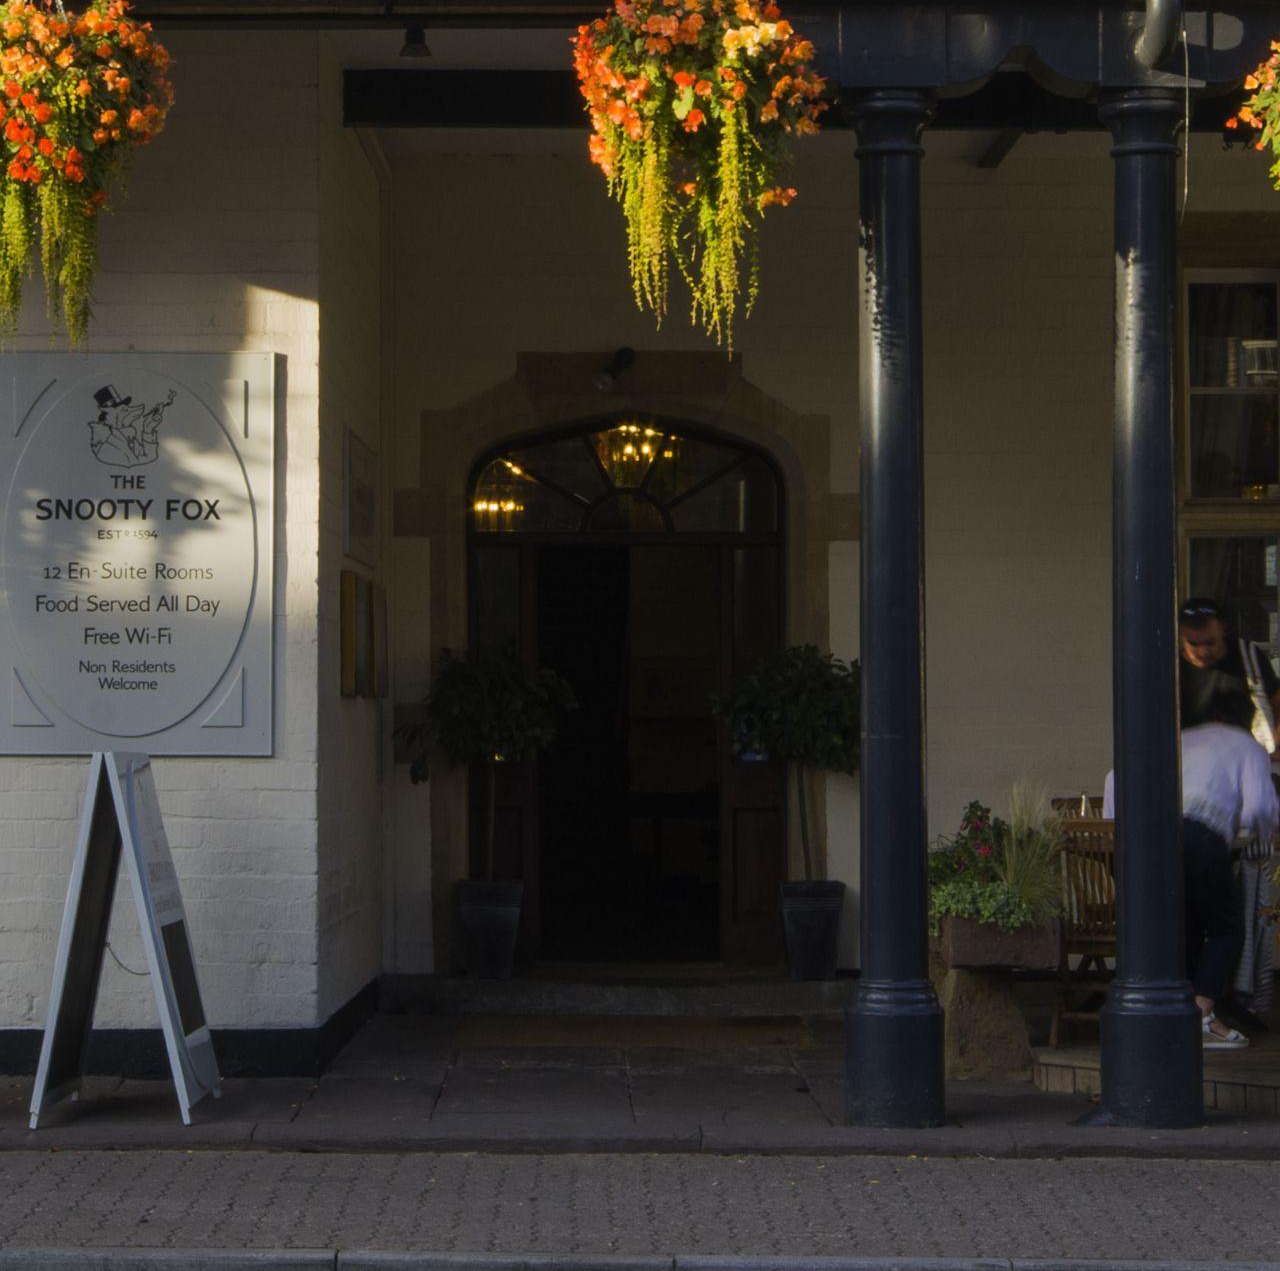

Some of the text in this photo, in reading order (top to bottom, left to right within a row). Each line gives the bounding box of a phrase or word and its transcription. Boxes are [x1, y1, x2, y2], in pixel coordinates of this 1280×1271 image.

[110, 475, 146, 489] THE
[36, 499, 221, 521] SNOOTY FOX
[43, 567, 61, 580] 12
[155, 562, 214, 580] Rooms
[35, 595, 221, 617] Food Served All Day
[84, 628, 172, 645] Free Wi-Fi
[79, 659, 176, 674] Non Residents
[98, 677, 159, 690] Welcome
